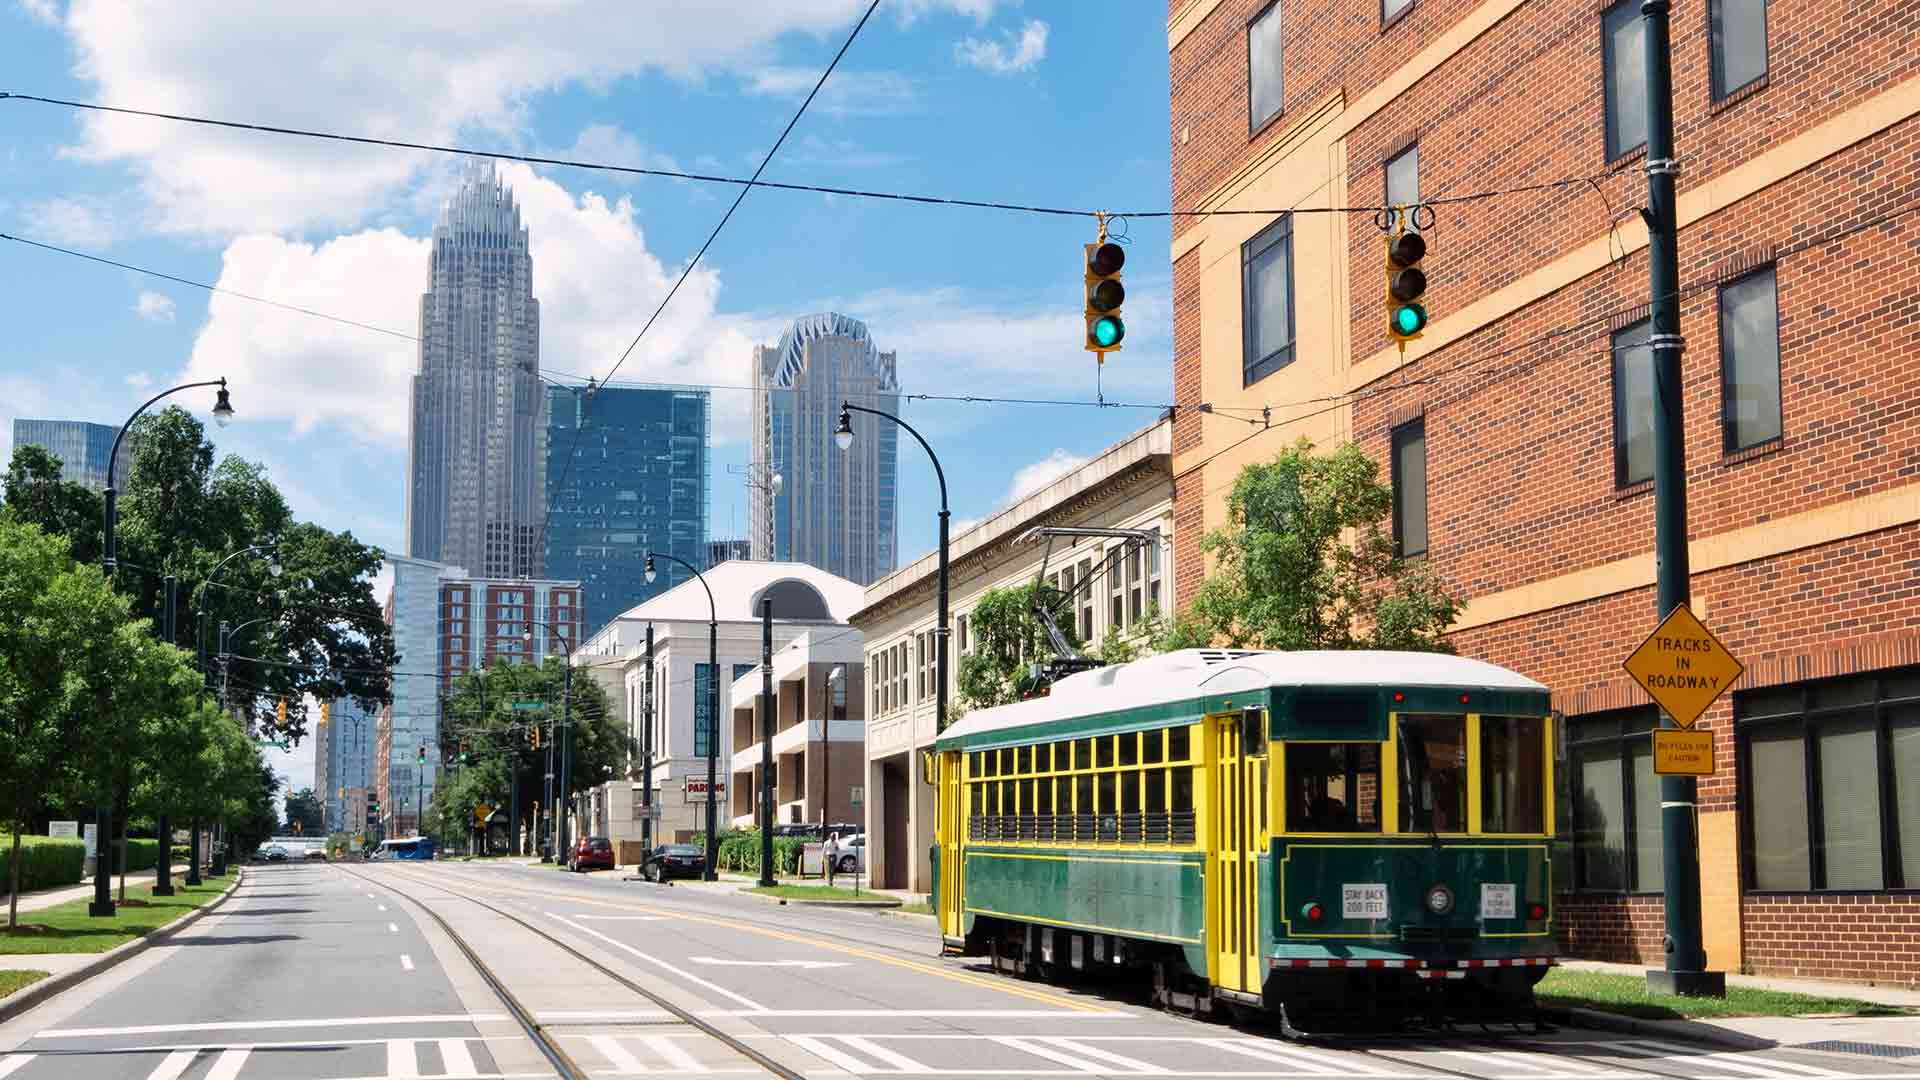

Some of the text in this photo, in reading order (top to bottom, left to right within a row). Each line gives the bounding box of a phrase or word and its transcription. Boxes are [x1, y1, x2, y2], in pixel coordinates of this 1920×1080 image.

[1656, 638, 1711, 652] TRACKS
[1676, 656, 1690, 670] IN
[1647, 674, 1719, 689] ROADWAY
[1344, 889, 1384, 900] STAY BACK
[1346, 902, 1383, 912] 200 FEET
